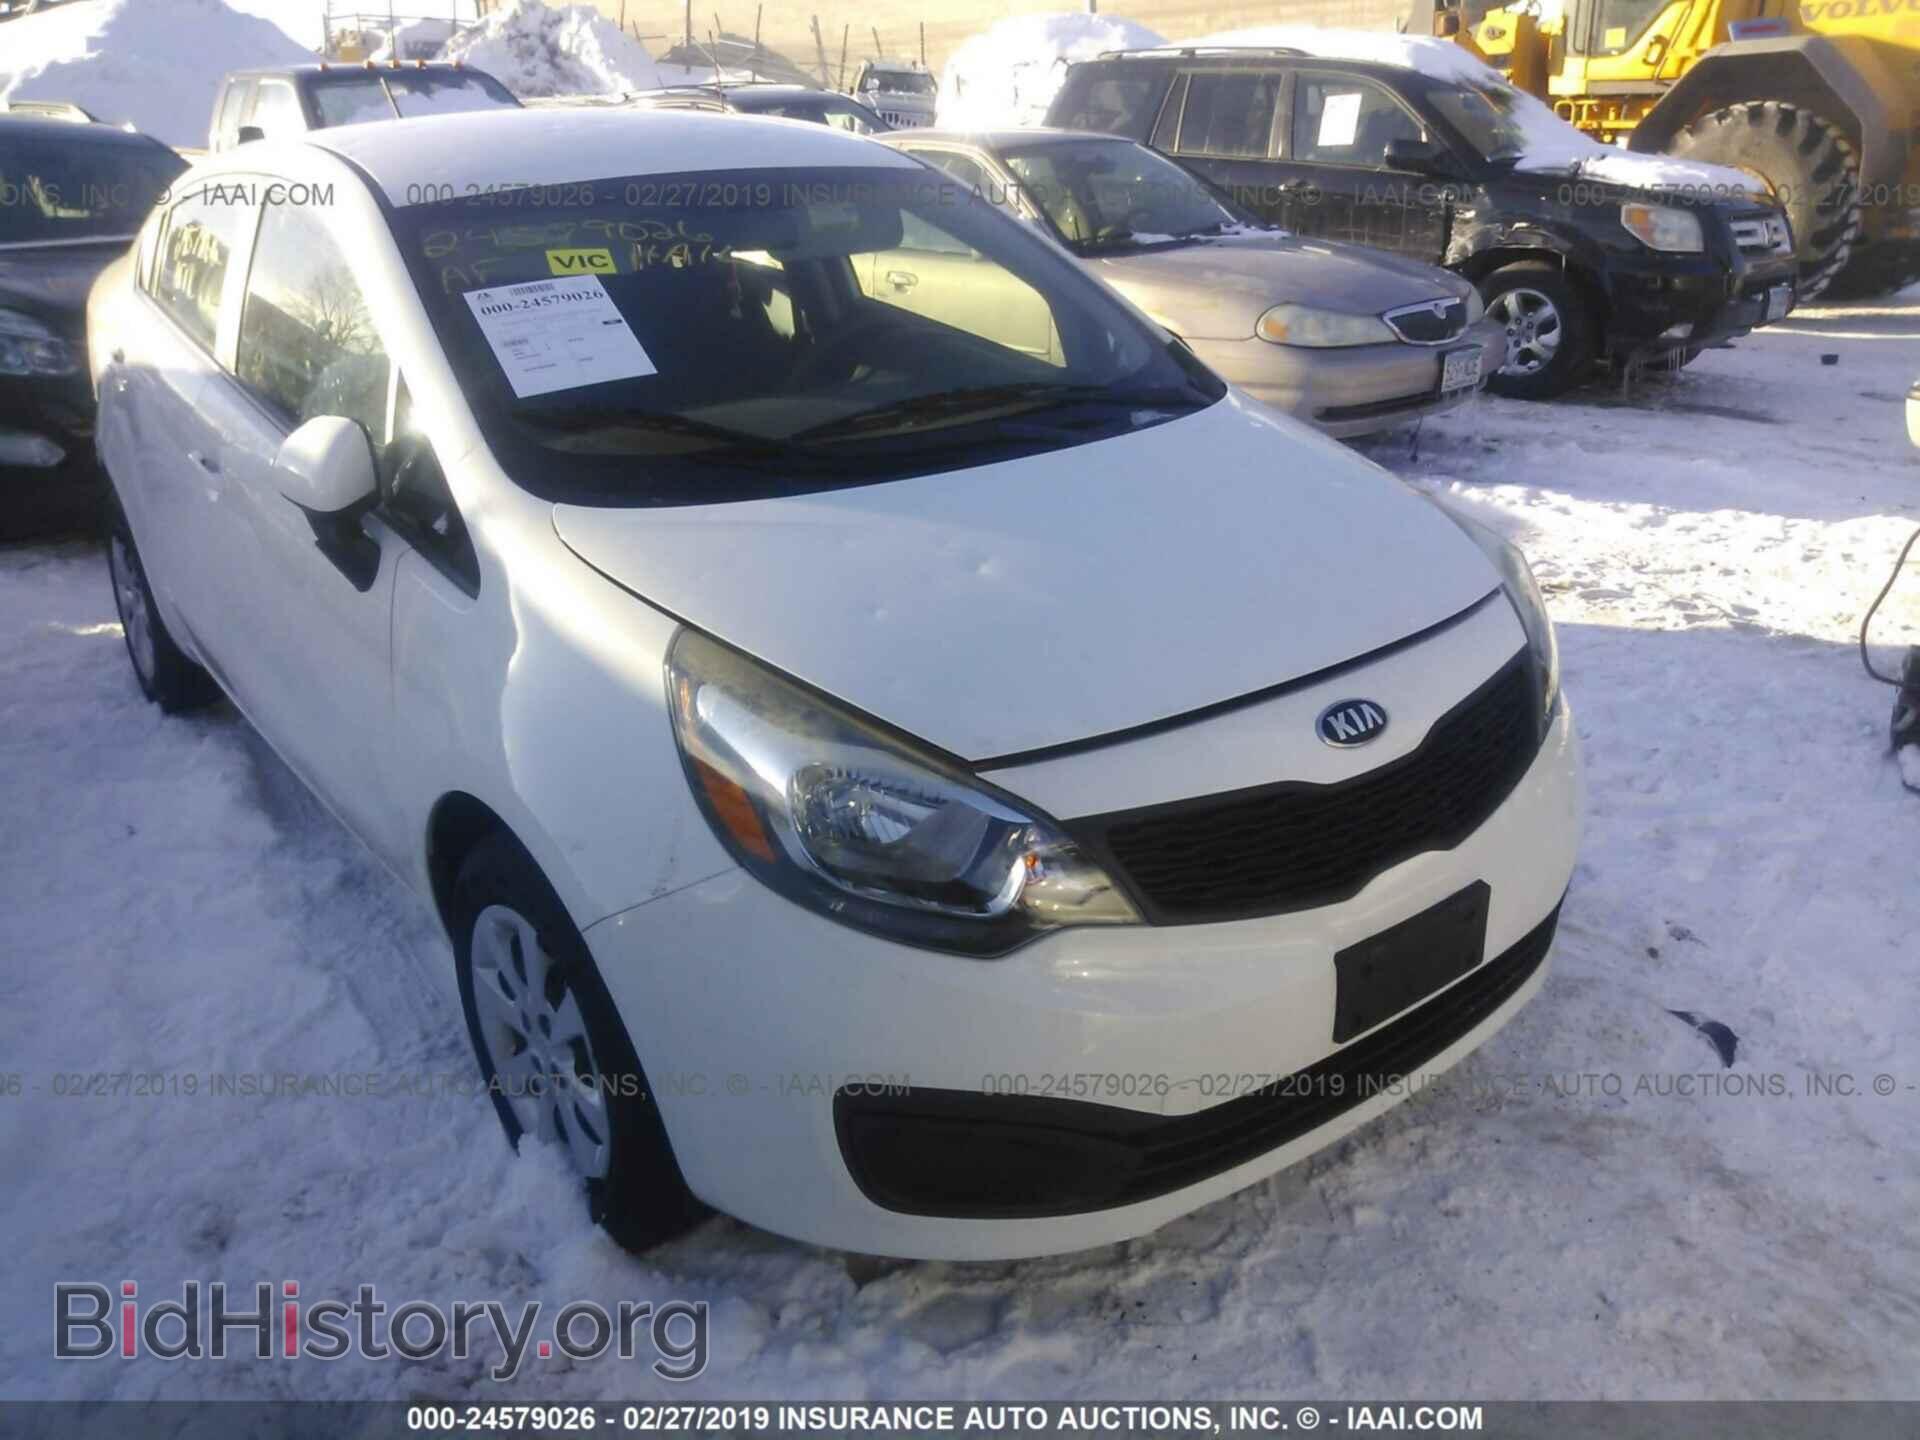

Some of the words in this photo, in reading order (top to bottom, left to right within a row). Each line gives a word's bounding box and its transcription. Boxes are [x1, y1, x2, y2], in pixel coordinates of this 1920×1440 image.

[553, 253, 611, 270] VIC
[480, 289, 604, 316] 000-24579026
[1326, 703, 1384, 741] KIA
